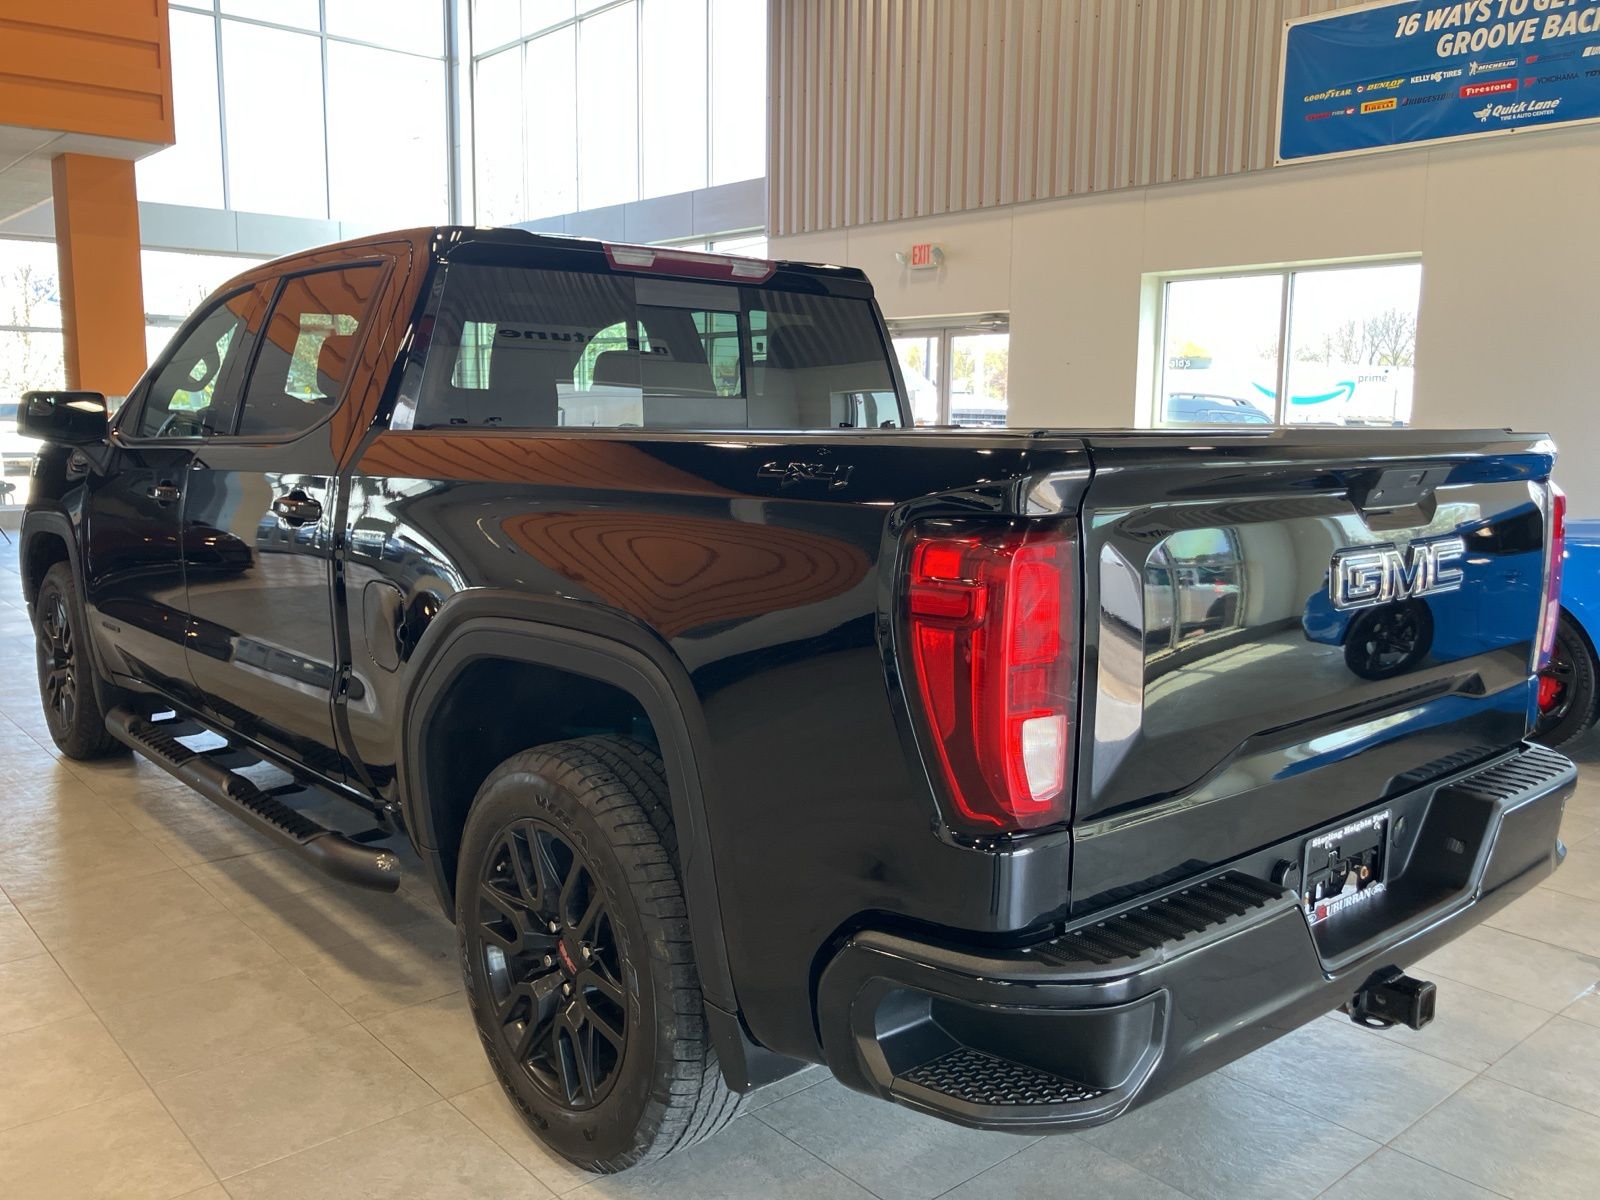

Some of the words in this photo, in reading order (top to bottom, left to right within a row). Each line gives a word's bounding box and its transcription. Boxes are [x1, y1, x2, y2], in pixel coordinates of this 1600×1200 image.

[1395, 13, 1421, 38] 16
[1424, 0, 1491, 32] WAYS
[1498, 0, 1525, 19] TO
[1533, 0, 1576, 11] GE
[1436, 18, 1540, 58] GROOVE
[1478, 60, 1516, 71] MICHELIN
[1410, 74, 1431, 84] KELLY
[1443, 69, 1462, 79] TIRES
[1537, 72, 1580, 85] YOKOHAMA
[1366, 78, 1406, 91] DUNLOP
[1465, 82, 1513, 97] Firestone
[1304, 89, 1352, 102] GOODYEAR
[1364, 101, 1394, 112] PIRELLI
[1491, 101, 1527, 116] Quick
[1527, 98, 1560, 111] Lane
[1517, 111, 1531, 119] AUTO
[1532, 109, 1555, 117] CENTER
[912, 244, 931, 265] EXIT
[1357, 373, 1388, 384] prime
[1329, 537, 1465, 611] GMC
[1312, 829, 1344, 848] Sterling
[1344, 818, 1372, 835] Heights
[1373, 810, 1389, 823] Ford
